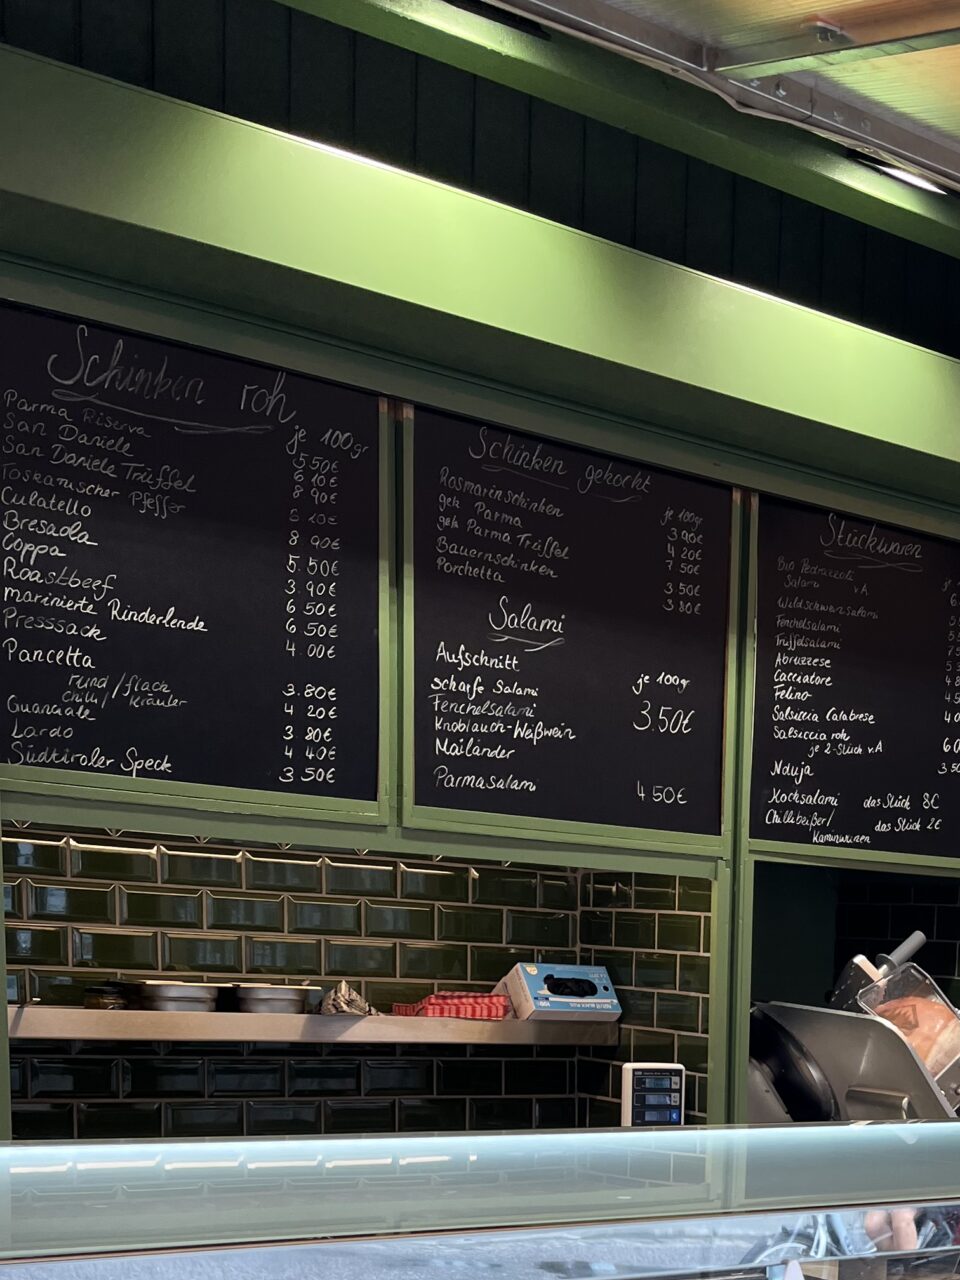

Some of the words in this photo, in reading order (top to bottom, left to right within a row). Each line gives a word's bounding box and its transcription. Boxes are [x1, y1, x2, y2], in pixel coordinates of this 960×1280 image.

[48, 325, 205, 404] Schinken
[241, 371, 297, 423] roh
[4, 390, 73, 421] Parma
[83, 408, 151, 438] Riserva
[4, 413, 47, 436] San
[58, 425, 134, 457] Daniele
[286, 425, 307, 455] je
[320, 428, 369, 459] 100gr
[3, 435, 45, 456] San
[50, 444, 118, 478] Daniele
[121, 463, 197, 493] Trüffel
[468, 426, 568, 476] Schinken
[577, 462, 651, 495] gekocht
[1, 486, 92, 517] Culatello
[2, 463, 121, 498] Toskanischer
[129, 491, 187, 519] Pfeffer
[3, 510, 98, 546] Bresaola
[474, 501, 523, 529] Parma
[660, 506, 675, 526] je
[466, 518, 513, 545] Parma
[820, 512, 924, 559] Stückwaren
[2, 532, 67, 566] Coppa
[3, 556, 117, 600] Roastbeef
[437, 556, 507, 583] Porchetta
[108, 598, 209, 632] Rinderlende
[488, 595, 566, 634] Salami
[3, 638, 96, 669] Pancetta
[436, 641, 521, 671] Aufschnitt
[775, 652, 832, 669] Abruzzese
[492, 679, 540, 697] Salami
[632, 673, 650, 695] je
[773, 669, 833, 687] Cacciatore
[773, 683, 812, 701] Felino
[7, 694, 97, 721] Guanciale
[427, 693, 538, 719] Fenchelsalami
[825, 706, 876, 725] Calabrese
[11, 718, 74, 739] Lardo
[8, 740, 115, 768] Südtiroler
[120, 746, 173, 778] Speck
[770, 759, 815, 785] Nduja
[863, 795, 881, 808] das
[882, 792, 911, 811] Stück
[874, 819, 892, 832] das
[894, 817, 921, 831] Stück
